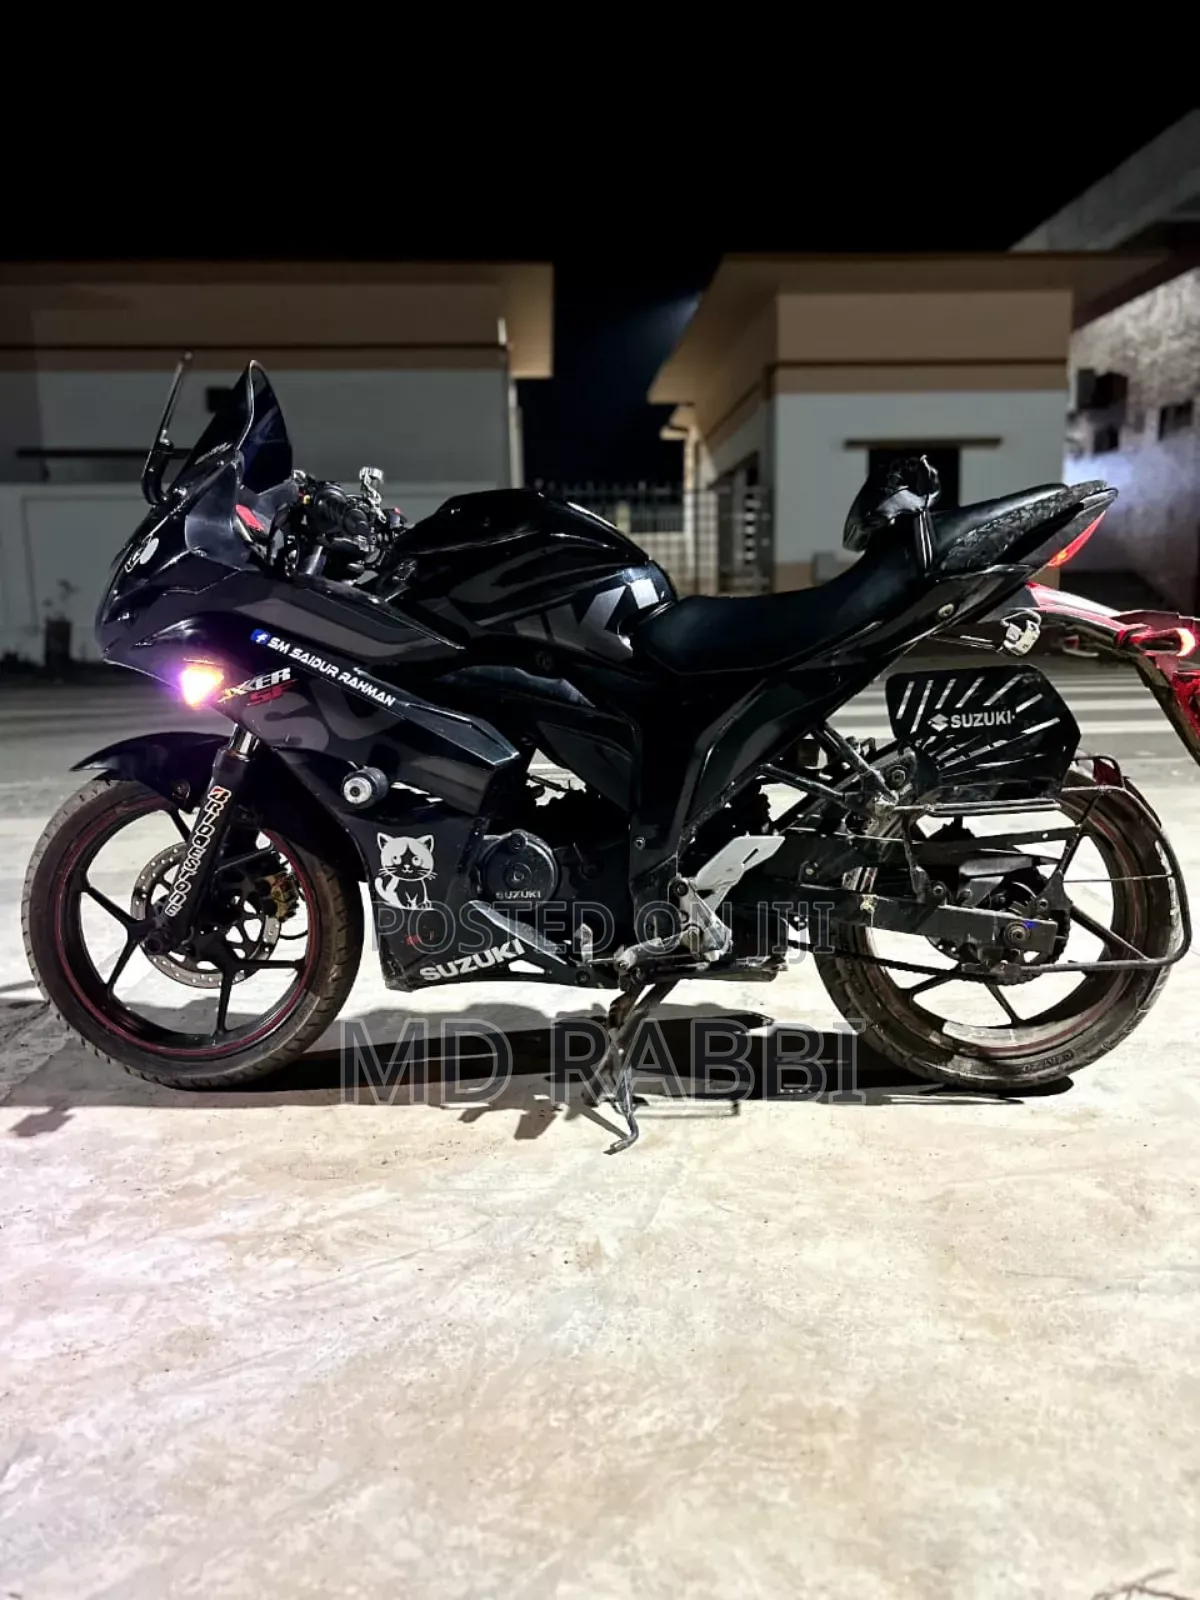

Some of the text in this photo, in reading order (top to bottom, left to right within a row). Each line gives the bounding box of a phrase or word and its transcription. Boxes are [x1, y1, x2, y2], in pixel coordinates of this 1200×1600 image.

[267, 637, 291, 655] SM
[288, 648, 339, 678] SAIDUR
[338, 672, 396, 707] RAHMAN
[950, 710, 1012, 729] SUZUKI
[496, 890, 542, 900] SUZUKI
[419, 938, 526, 982] SUZUKI
